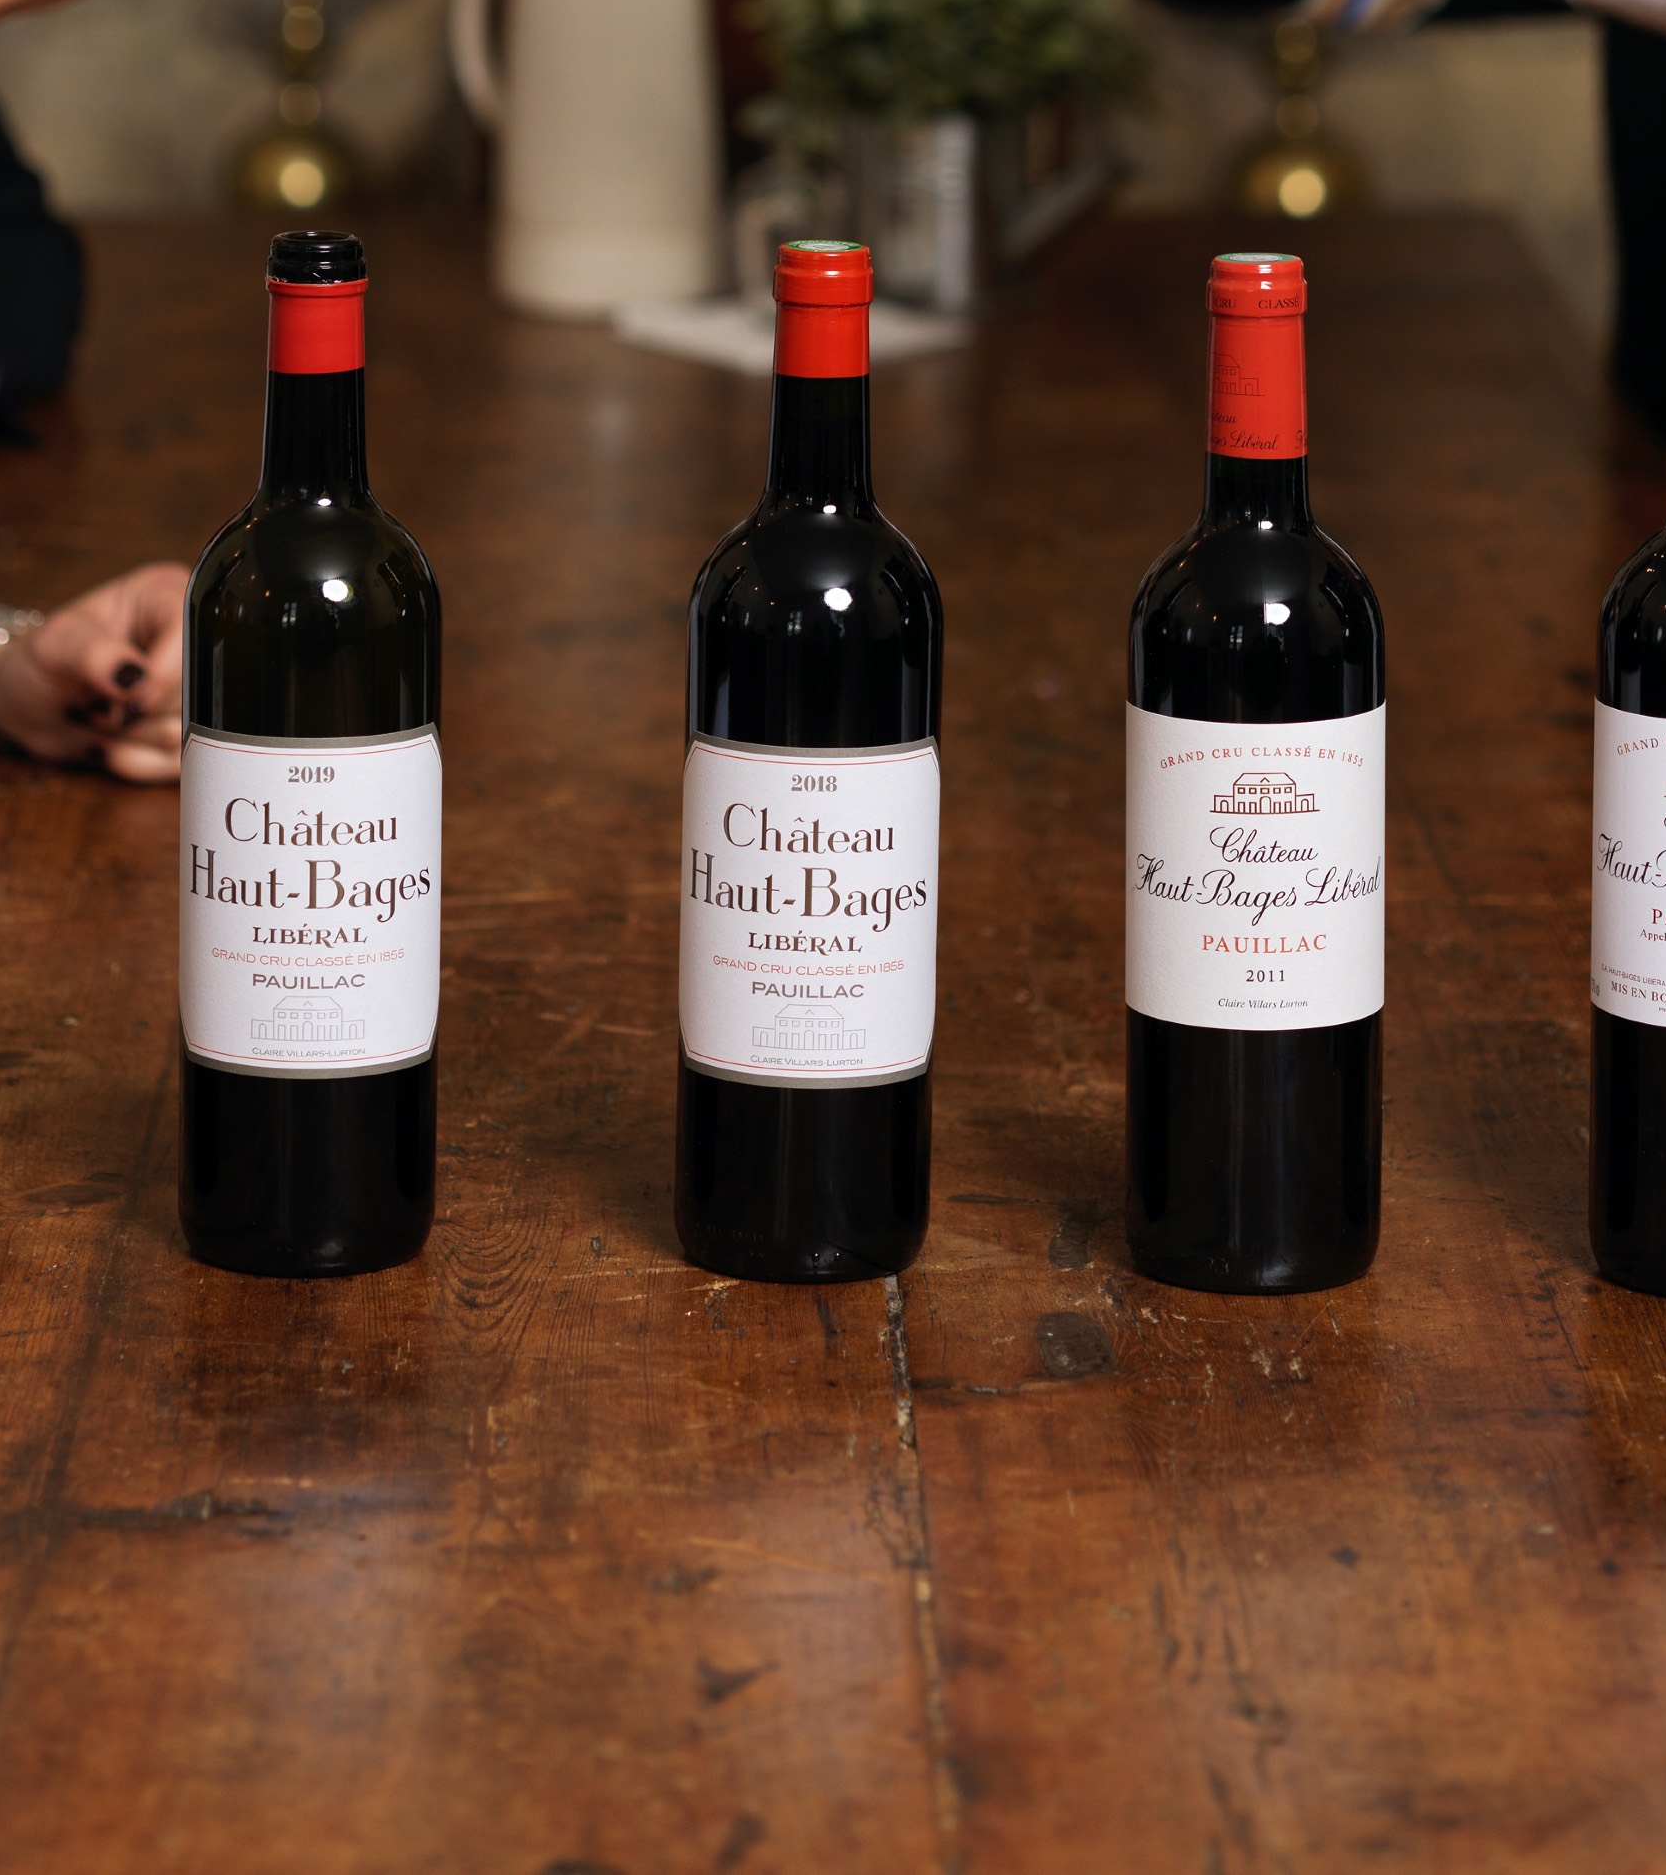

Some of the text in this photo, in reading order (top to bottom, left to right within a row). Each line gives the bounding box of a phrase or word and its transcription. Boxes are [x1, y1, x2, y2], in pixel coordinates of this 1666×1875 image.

[1258, 294, 1300, 310] CLASSÉ
[1230, 429, 1280, 450] Libéral
[1617, 737, 1659, 756] GRAND
[1160, 745, 1364, 769] GRAND CRU CLASSÉ EN 1855
[288, 766, 335, 784] 2019
[791, 774, 838, 792] 2018
[224, 797, 398, 847] Château
[723, 803, 895, 855] Château
[1209, 826, 1319, 863] Château
[190, 843, 431, 923] Haut-Bages
[690, 847, 927, 933] Haut-Bages
[1135, 853, 1381, 926] Haut-Bages Libéral
[252, 924, 368, 949] LIBÉRAL
[748, 930, 863, 956] LIBÉRAL
[1201, 934, 1327, 954] PAUILLAC
[212, 947, 405, 967] GRAND CRU CLASSÉ EN 1855
[713, 955, 904, 976] GRAND CRU CLASSÉ EN 1855
[252, 973, 366, 990] PAUILLAC
[1245, 970, 1286, 983] 2011
[1608, 966, 1641, 983] HAUT-BAGES
[751, 981, 865, 999] PAUILLAC
[1611, 980, 1628, 995] MIS
[1631, 987, 1647, 1000] EN
[1218, 998, 1308, 1009] Claire Villars Lurton
[251, 1047, 366, 1058] CLAIRE VILLARS-LURTON
[750, 1054, 863, 1067] CLAIRE VILLARS-LURTON
